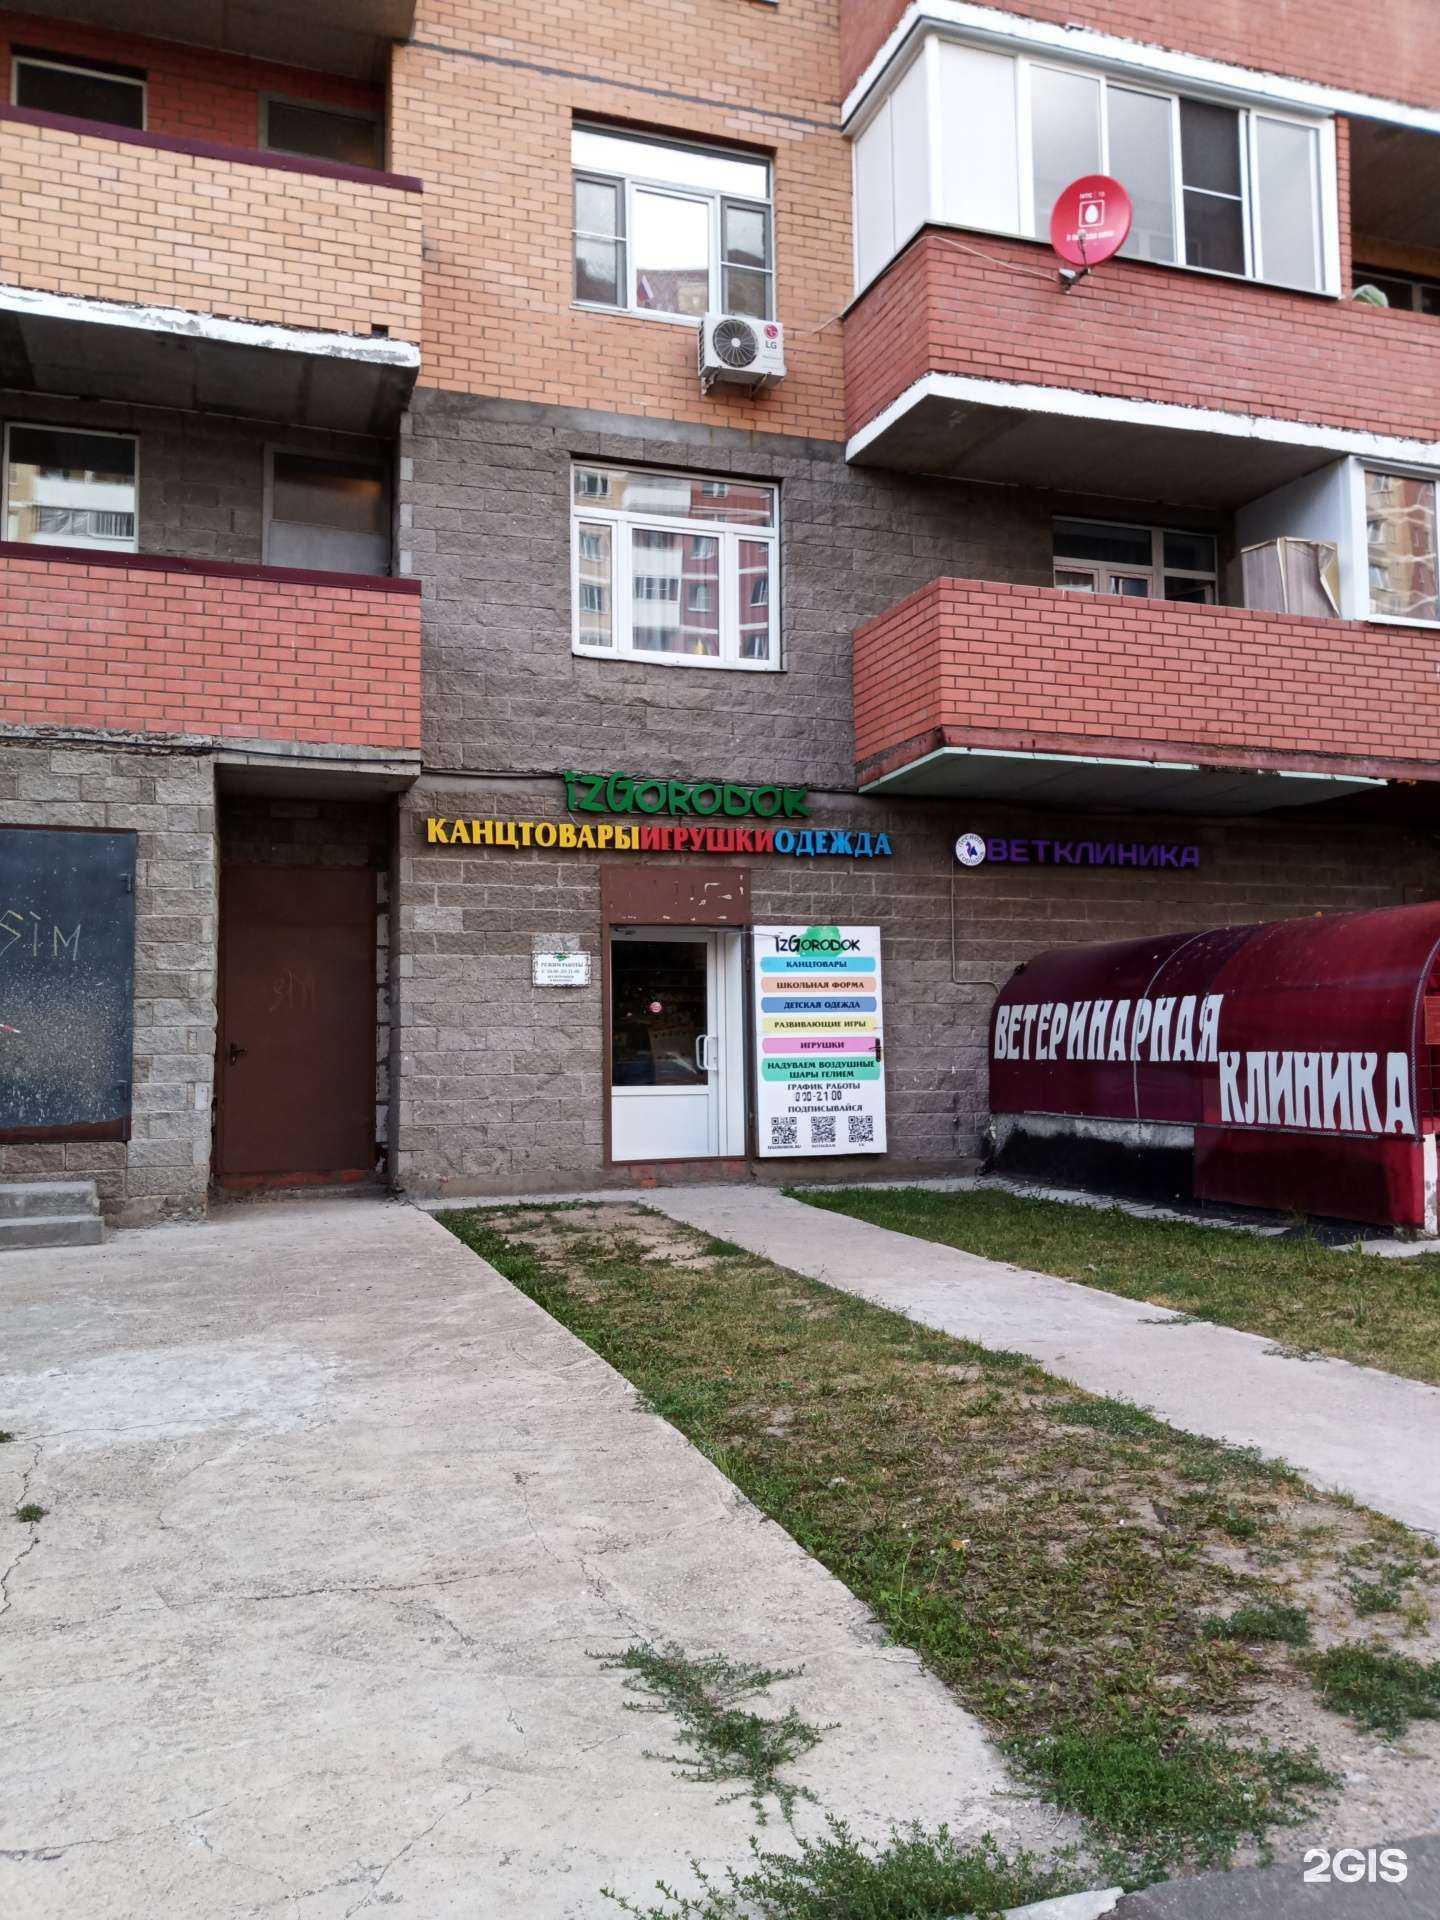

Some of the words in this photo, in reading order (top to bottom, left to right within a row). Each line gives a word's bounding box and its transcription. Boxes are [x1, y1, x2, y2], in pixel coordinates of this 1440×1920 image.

[765, 340, 778, 350] LG
[427, 817, 640, 850] КАНЦТОВАРЫ
[640, 825, 775, 852] ИГРУШКИ
[774, 828, 892, 858] ОДЕЖДА
[986, 838, 1200, 867] ВЕТКЛИНИКА
[786, 960, 847, 969] КАНЦТОВАРЫ
[776, 981, 829, 990] ШКОЛЬНАЯ
[831, 981, 865, 989] ФОРМА
[783, 1001, 821, 1010] ДЕТСКАЯ
[824, 1000, 861, 1010] ОДЕЖДА
[774, 1021, 841, 1029] РАЗВИВАЮЩИЕ
[844, 1020, 867, 1028] ИГРЫ
[994, 994, 1224, 1061] ВЕТЕРИНАРНАЯ
[800, 1041, 845, 1049] ИГРУШКИ
[767, 1061, 816, 1070] НАДУВАЕМ
[819, 1060, 875, 1069] ВОЗДУШНЫЕ
[789, 1071, 819, 1079] ШАРЫ
[821, 1070, 855, 1079] ГЕЛИЕМ
[787, 1083, 823, 1091] ГРАФИК
[826, 1082, 861, 1090] РАБОТЫ
[1218, 1052, 1416, 1135] КЛИНИКА
[788, 1103, 863, 1113] ПОДПИСЫВАЙСЯ
